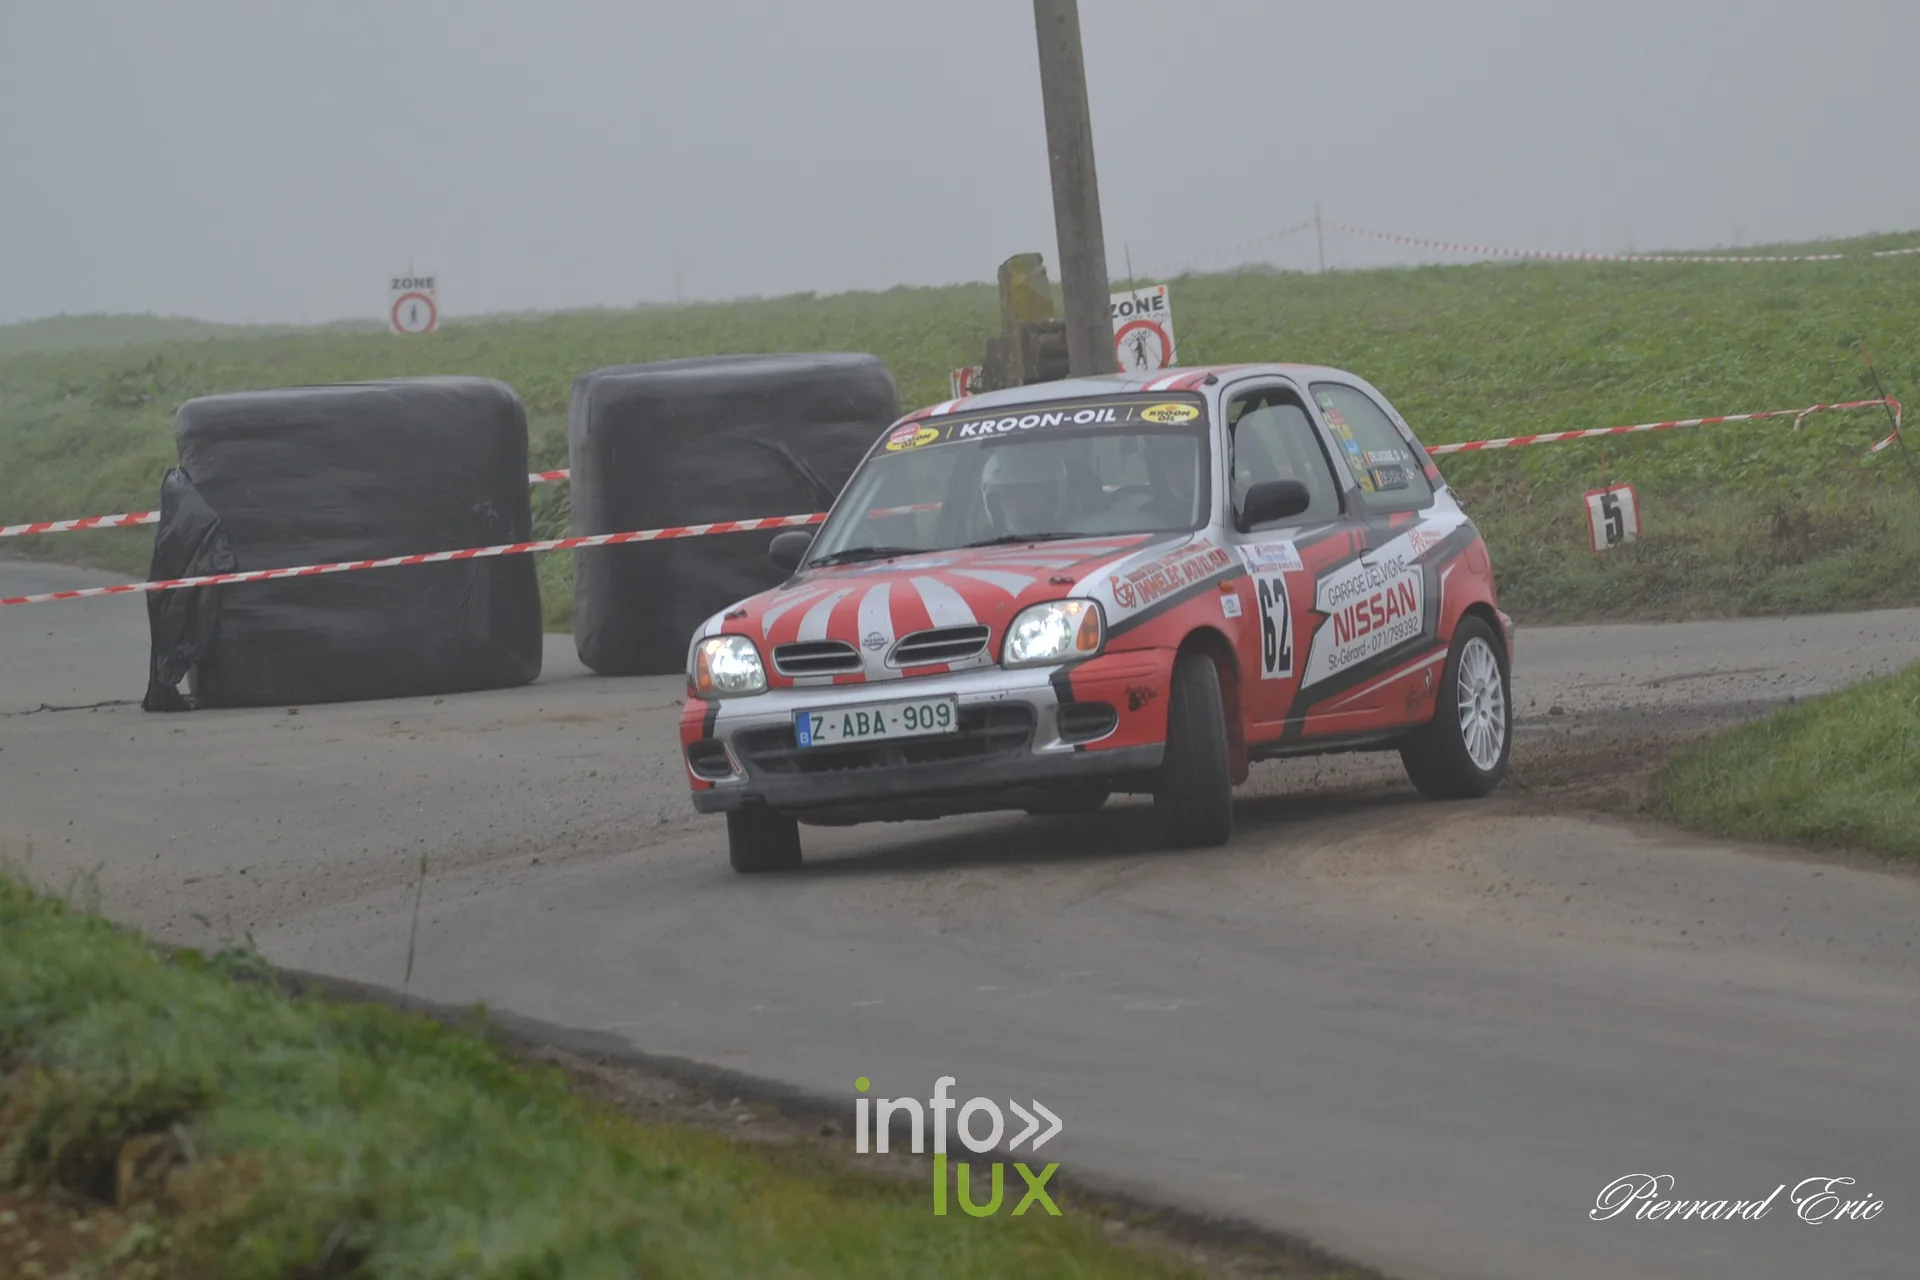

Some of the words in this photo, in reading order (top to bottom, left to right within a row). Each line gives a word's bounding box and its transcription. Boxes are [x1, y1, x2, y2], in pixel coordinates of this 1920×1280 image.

[391, 277, 436, 290] ZONE
[1111, 295, 1165, 319] ZONE
[959, 407, 1117, 437] KROON-OIL
[1149, 409, 1191, 417] KROON
[1600, 493, 1624, 543] 5
[1328, 575, 1366, 606] GARAGE
[1366, 554, 1407, 588] DELVIGNE
[1258, 578, 1292, 673] 62
[1333, 578, 1417, 647] NISSAN
[1328, 641, 1366, 671] St-Gérard
[1371, 617, 1418, 650] 071/799392
